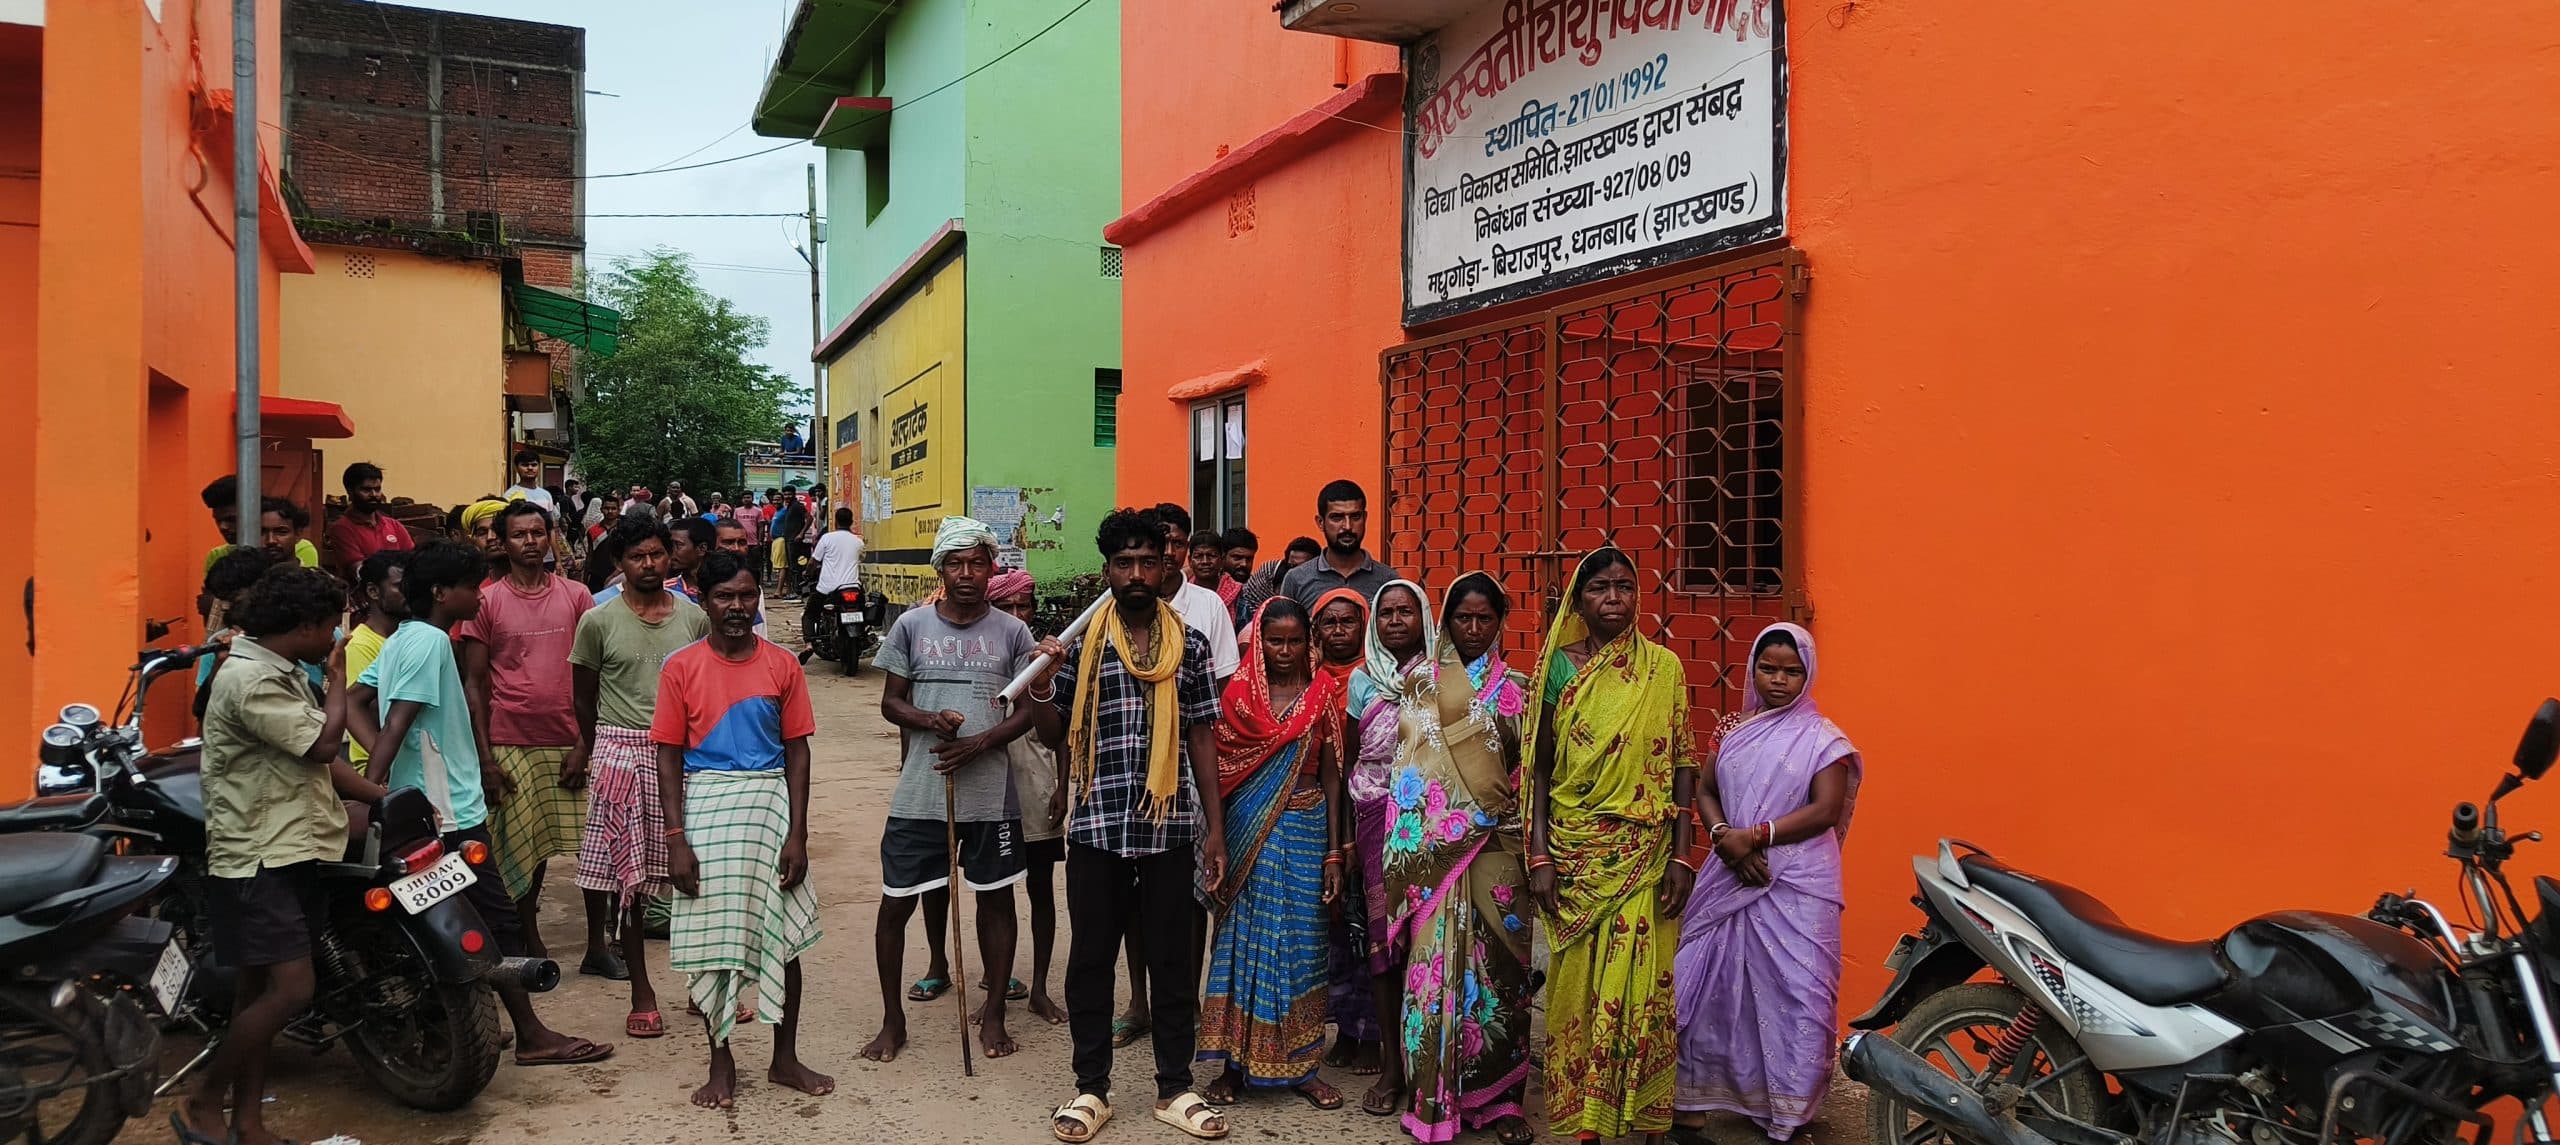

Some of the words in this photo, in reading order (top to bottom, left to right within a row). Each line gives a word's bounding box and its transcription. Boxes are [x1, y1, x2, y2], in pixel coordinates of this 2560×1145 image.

[1424, 187, 1457, 220] विद्या
[1460, 172, 1510, 207] विकास
[1643, 100, 1684, 148] द्वारा
[1474, 201, 1529, 242] निबंधन
[1572, 213, 1639, 255] धनबाद
[920, 635, 1001, 662] CASUAL
[998, 822, 1012, 857] RDAN
[412, 872, 467, 907] 8009
